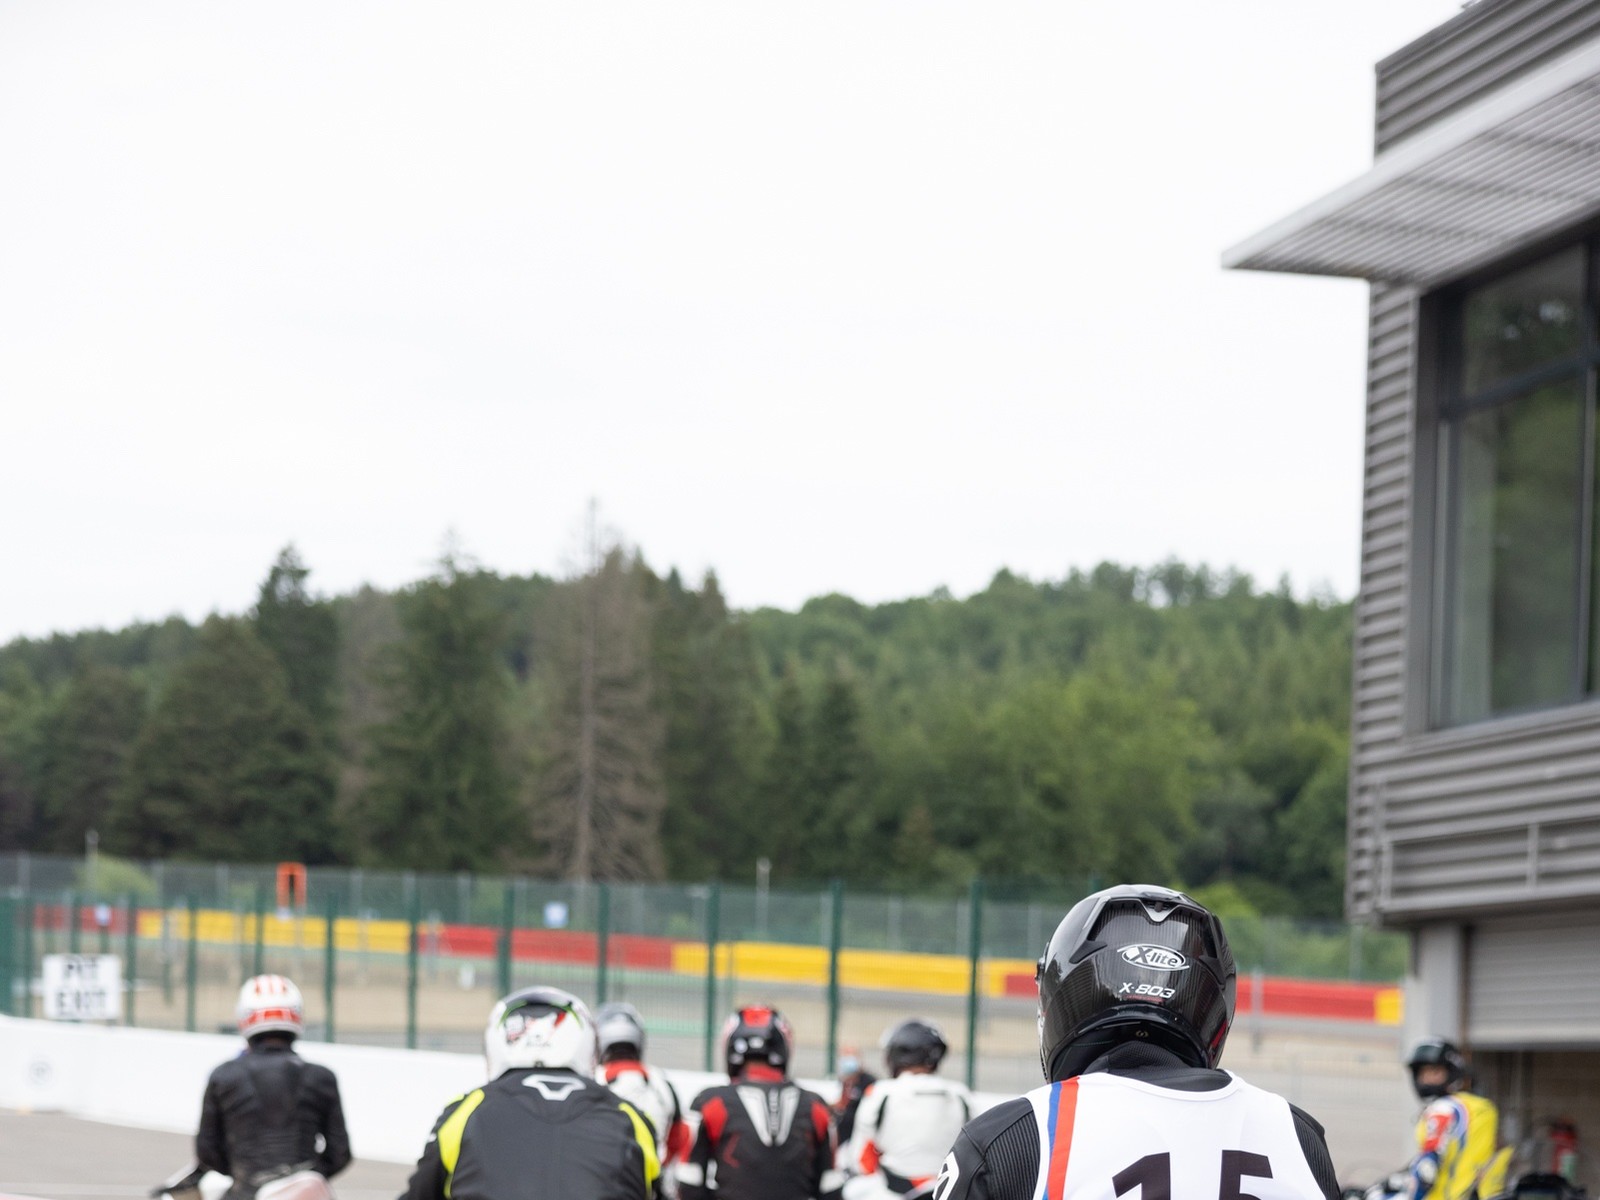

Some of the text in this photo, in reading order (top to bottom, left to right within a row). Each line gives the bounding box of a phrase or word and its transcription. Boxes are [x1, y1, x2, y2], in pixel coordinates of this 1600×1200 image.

[62, 955, 98, 978] PIT
[1128, 946, 1179, 967] X-lite
[56, 987, 106, 1015] EXIT
[1119, 982, 1176, 999] X-803
